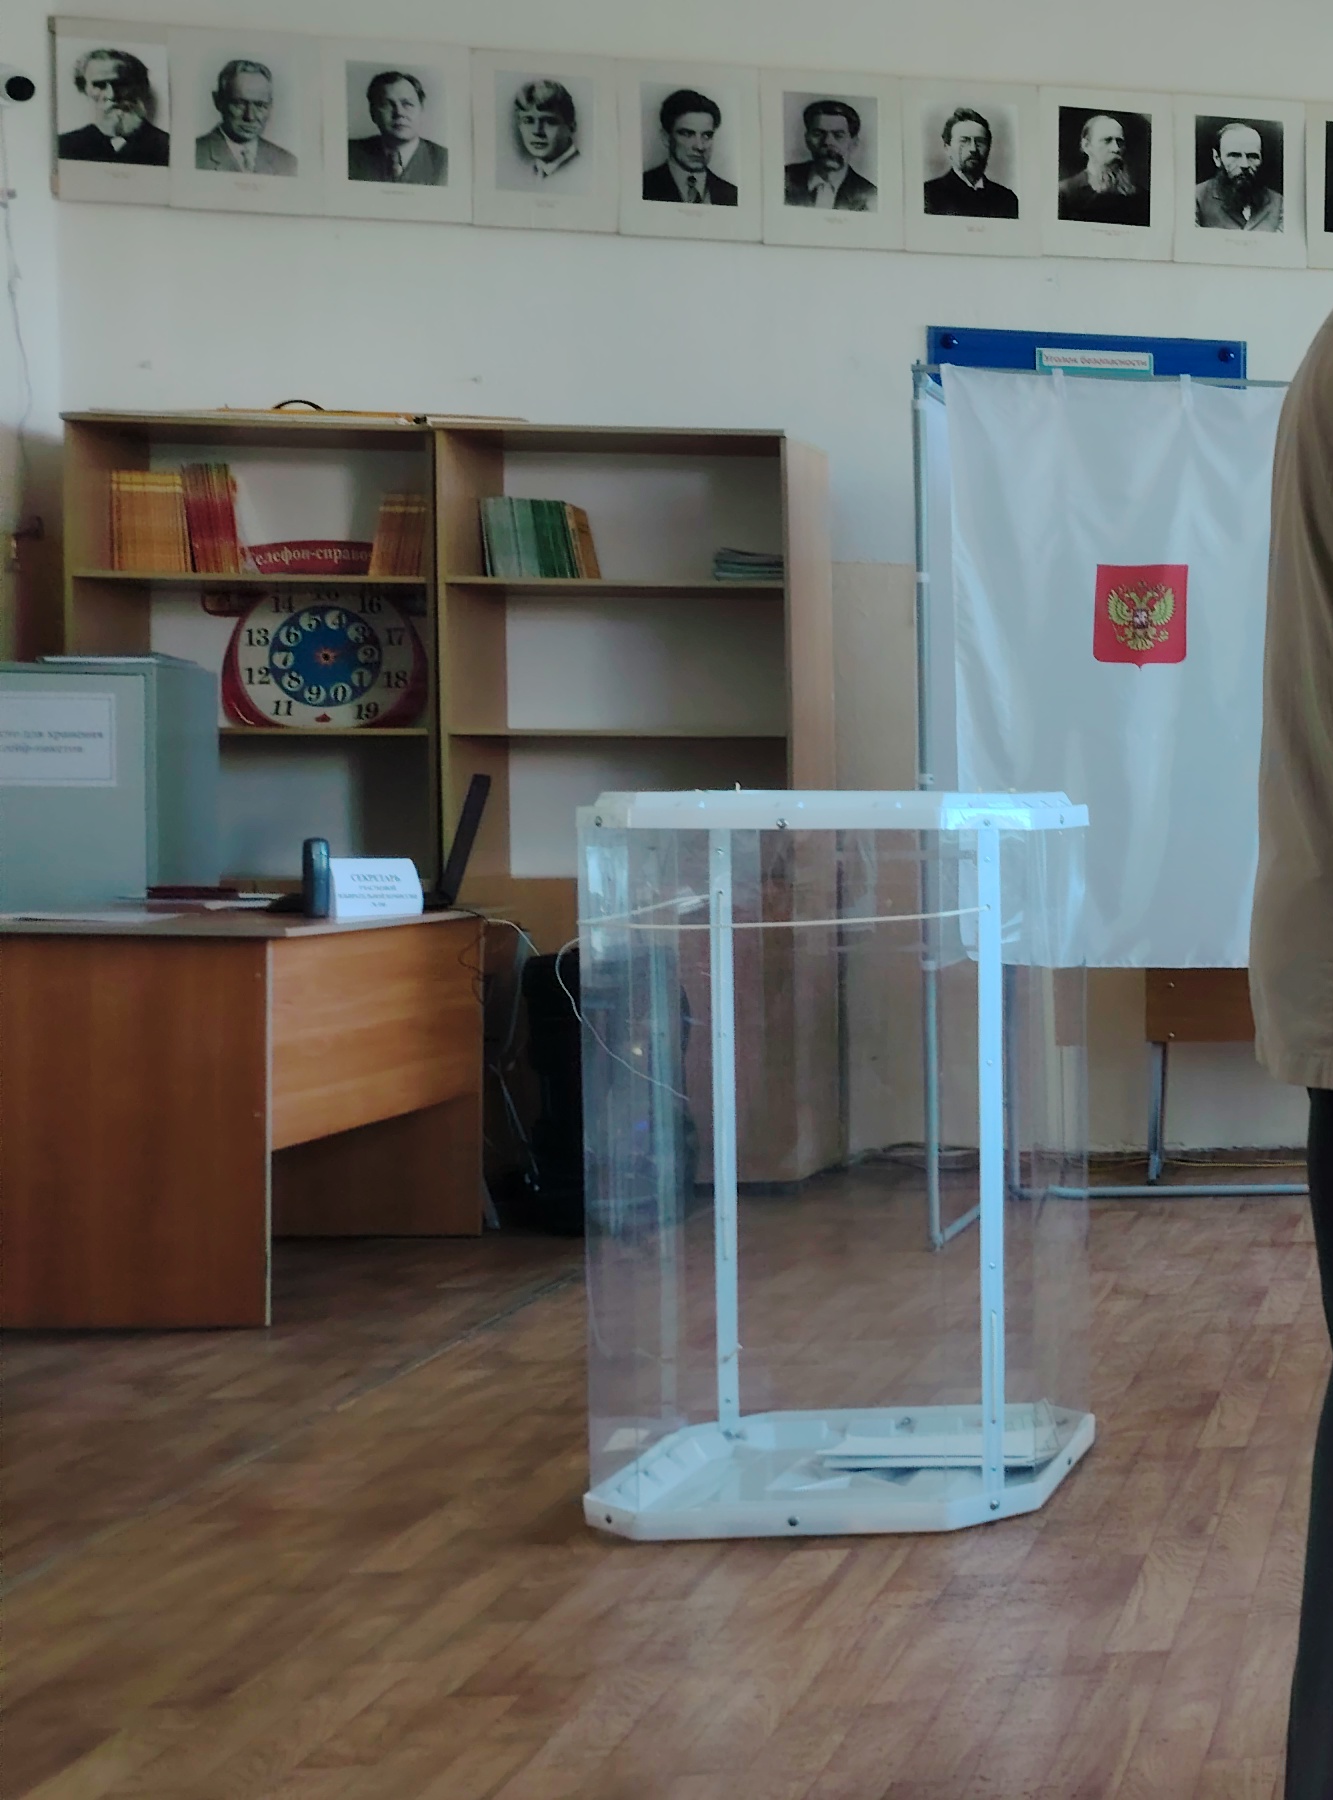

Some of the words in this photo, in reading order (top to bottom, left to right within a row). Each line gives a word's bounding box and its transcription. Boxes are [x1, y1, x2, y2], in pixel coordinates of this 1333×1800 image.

[271, 596, 294, 613] 14
[358, 596, 382, 614] 16
[306, 617, 321, 632] 5
[331, 612, 345, 627] 4
[245, 628, 270, 646] 13
[284, 630, 299, 645] 6
[354, 626, 367, 642] 3
[386, 628, 405, 646] 17
[277, 655, 289, 668] 7
[363, 648, 376, 662] 2
[245, 667, 271, 685] 12
[287, 672, 301, 689] 8
[355, 672, 367, 686] 1
[384, 671, 408, 689] 18
[308, 685, 321, 701] 9
[272, 700, 293, 717] 11
[353, 702, 379, 721] 19
